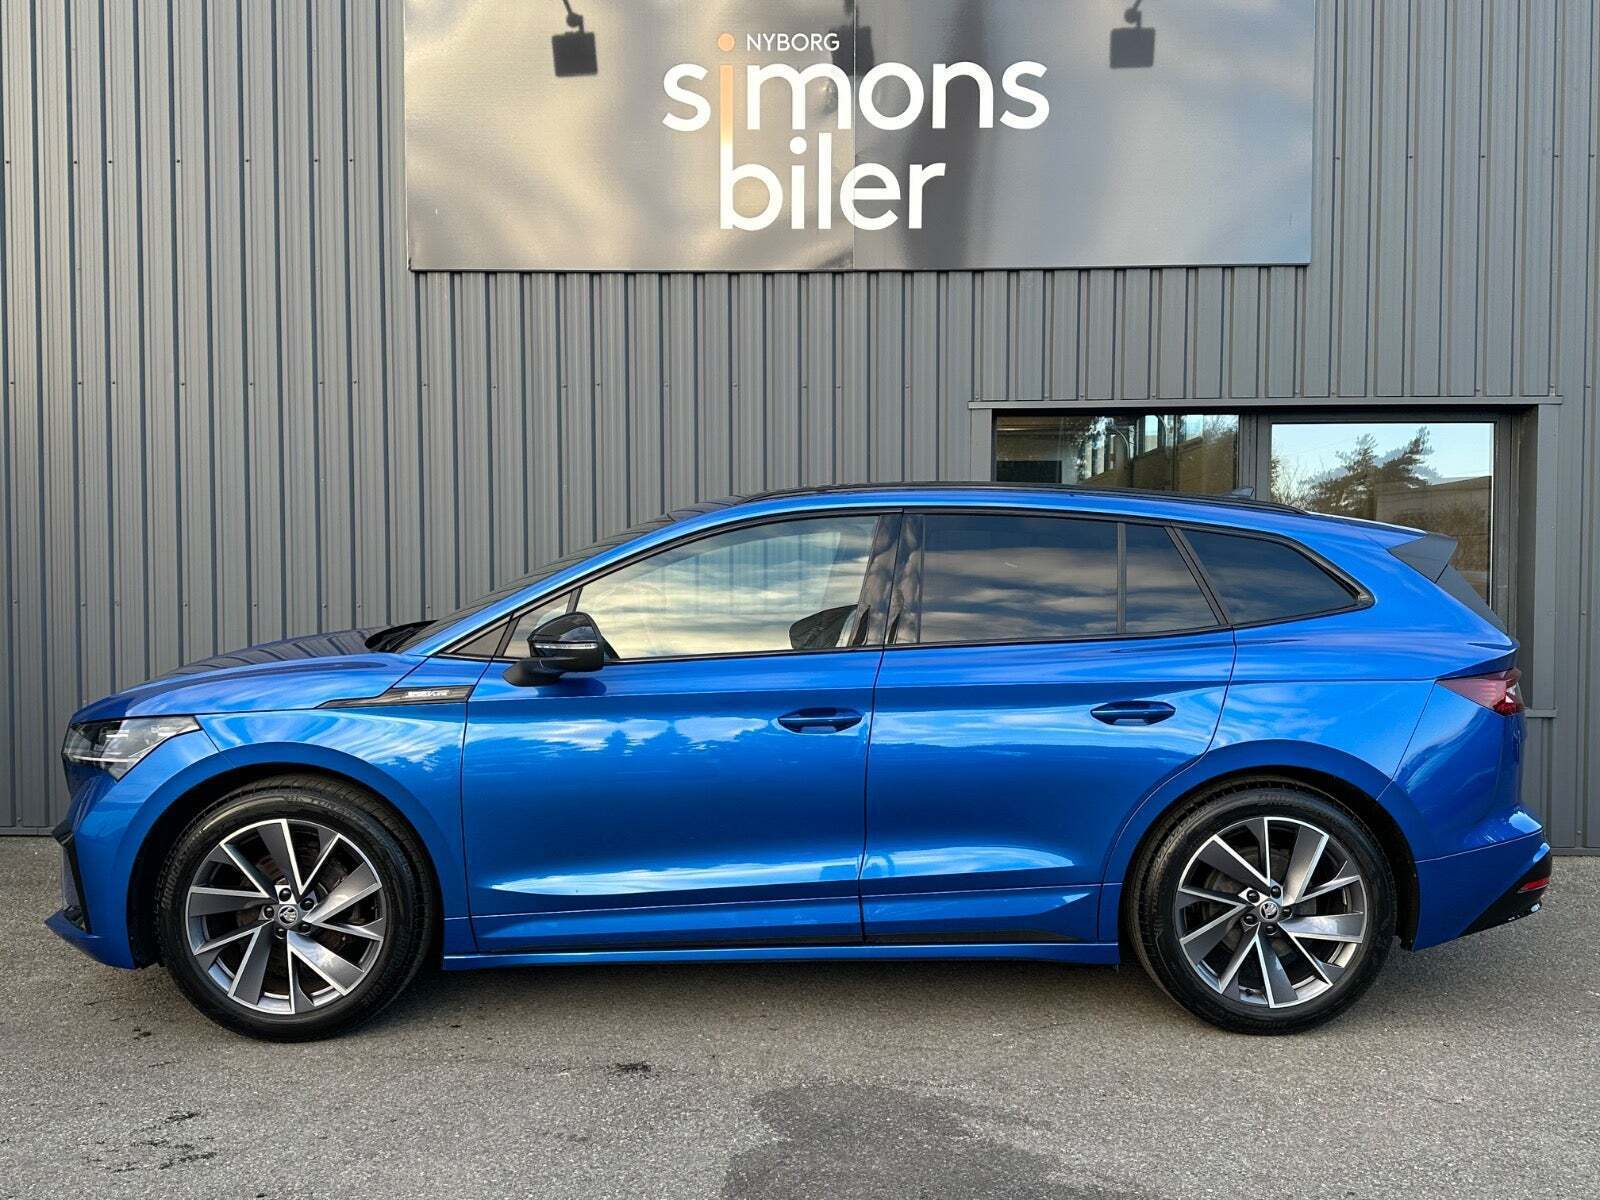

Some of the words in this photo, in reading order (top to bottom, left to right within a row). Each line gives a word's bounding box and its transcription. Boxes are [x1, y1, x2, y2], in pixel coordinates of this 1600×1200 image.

[662, 33, 1050, 132] simons
[746, 33, 840, 52] NYBORG
[719, 132, 947, 231] biler
